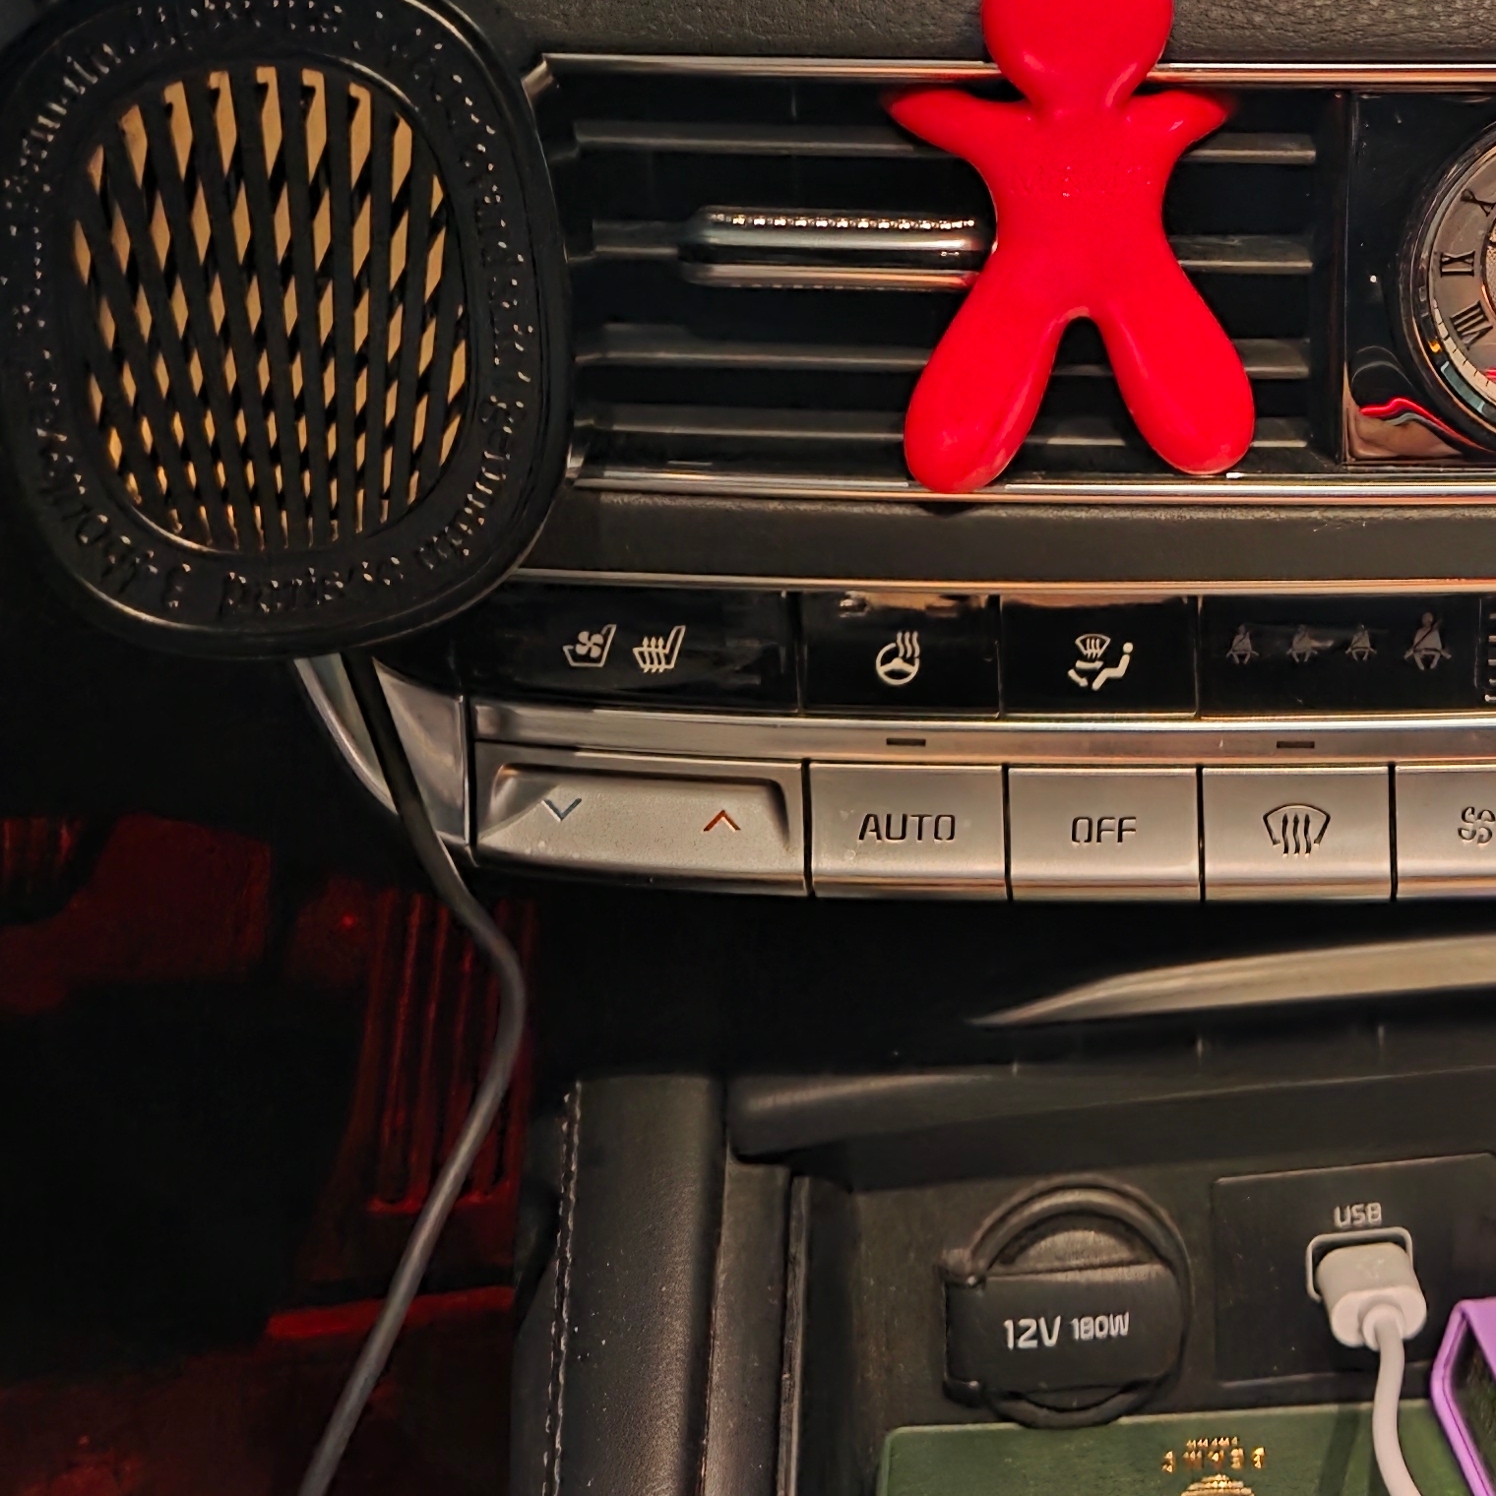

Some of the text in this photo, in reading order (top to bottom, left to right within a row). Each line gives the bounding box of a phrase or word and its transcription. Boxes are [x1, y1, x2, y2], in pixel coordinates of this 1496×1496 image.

[858, 813, 956, 842] AUTO
[1070, 816, 1137, 844] OFF
[1333, 1202, 1382, 1228] USB
[1004, 1312, 1130, 1350] 12V 180W
